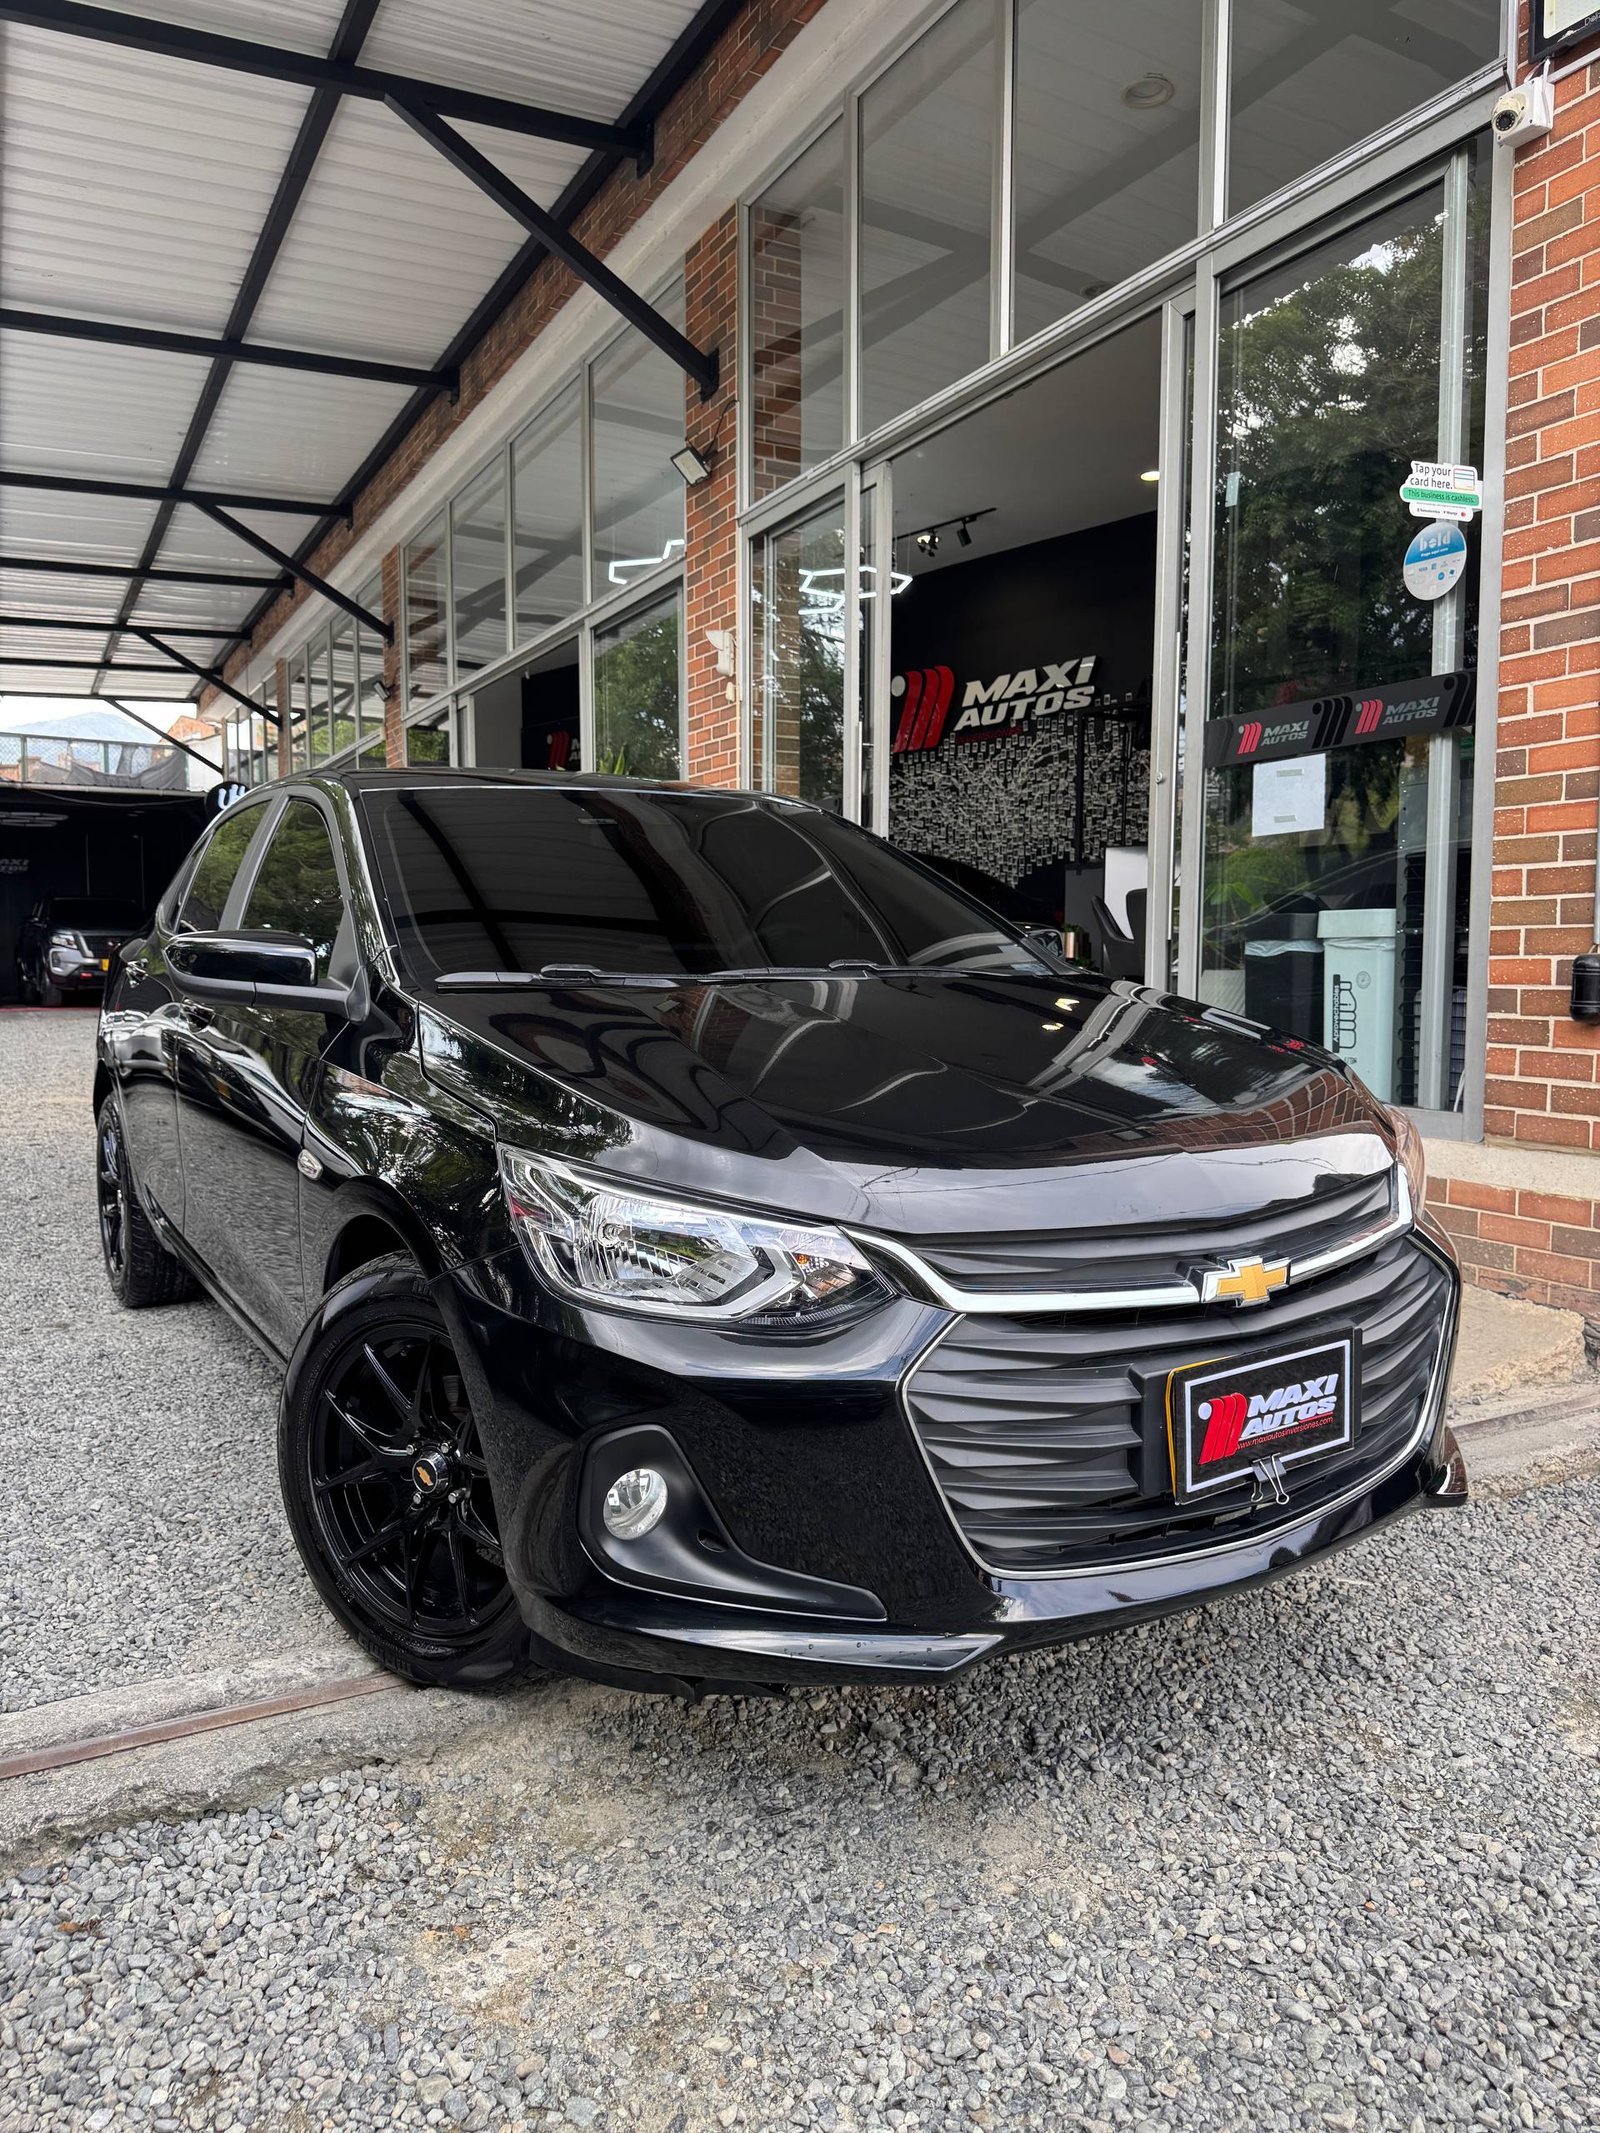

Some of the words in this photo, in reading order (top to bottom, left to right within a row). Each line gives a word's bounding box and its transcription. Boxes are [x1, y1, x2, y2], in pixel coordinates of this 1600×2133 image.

[1414, 462, 1430, 476] Tap
[1431, 465, 1451, 478] your
[1410, 476, 1430, 487] card
[1431, 477, 1453, 490] here.
[1408, 489, 1420, 498] This
[1420, 490, 1445, 501] business
[1445, 493, 1451, 501] is
[1419, 531, 1451, 552] bold
[961, 655, 1097, 708] MAXI
[953, 685, 1095, 732] AUTOS
[1385, 696, 1441, 716] MAXI
[1382, 707, 1438, 726] AUTOS
[1261, 730, 1309, 747] AUTOS
[1263, 720, 1310, 738] MAXI
[1247, 1373, 1339, 1418] MAXI
[1240, 1396, 1337, 1440] AUTOS
